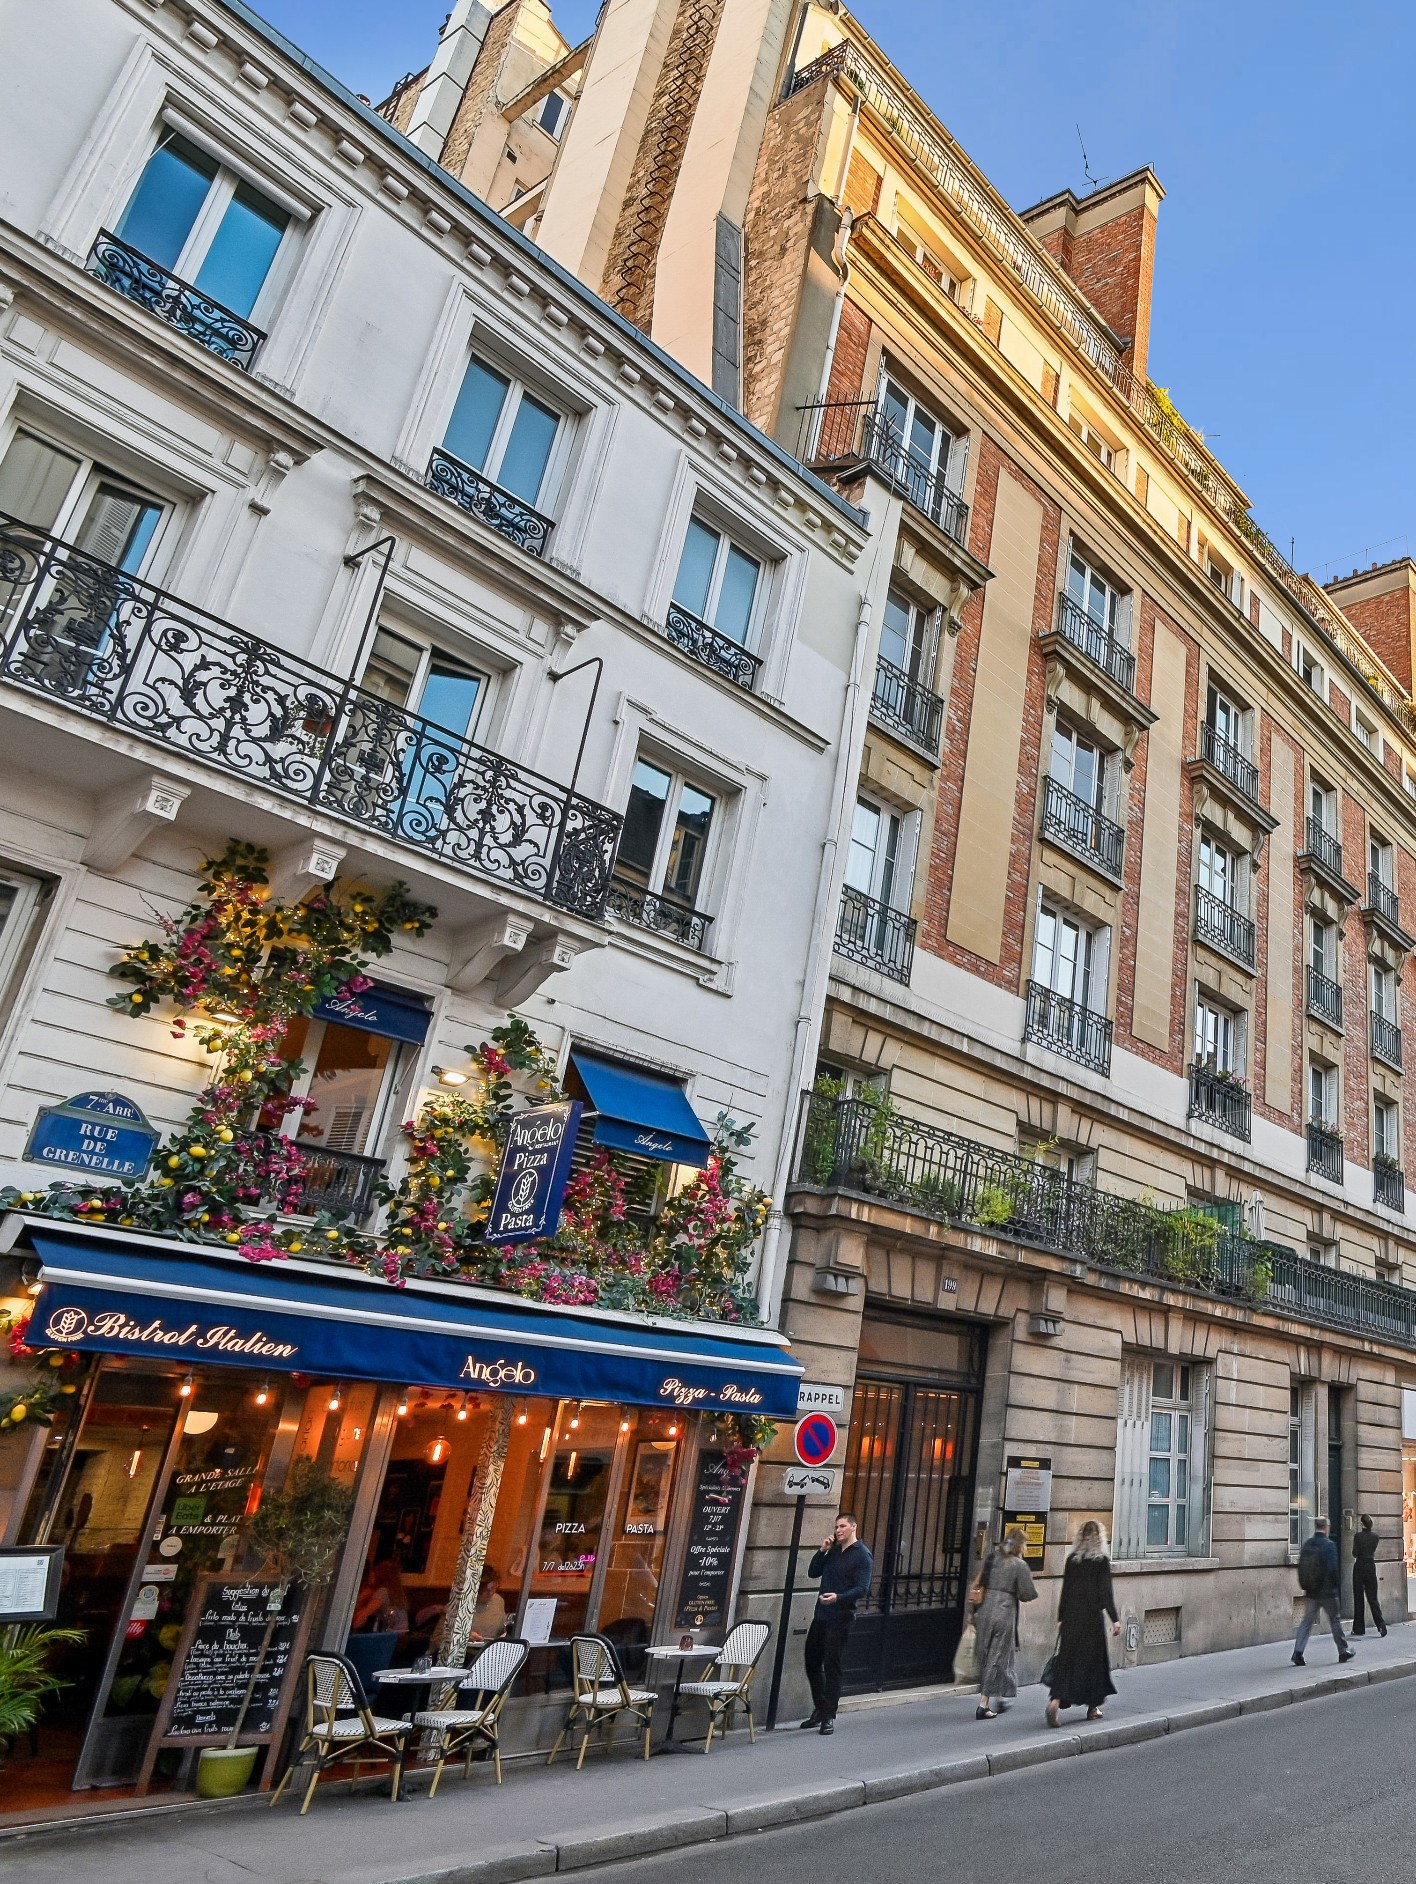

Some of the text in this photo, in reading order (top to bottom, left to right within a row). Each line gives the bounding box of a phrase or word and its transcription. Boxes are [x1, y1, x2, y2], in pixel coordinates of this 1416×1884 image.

[79, 1123, 118, 1141] RUE
[81, 1139, 107, 1154] DE
[42, 1146, 135, 1174] GRENELLE
[513, 1152, 548, 1170] Pizza
[499, 1213, 534, 1231] Pasta
[88, 1312, 299, 1357] Bistrot Italien
[459, 1355, 535, 1387] Angelo
[659, 1378, 708, 1405] Pizza
[719, 1384, 763, 1405] Pasta
[799, 1390, 841, 1406] RAPPEL
[702, 1506, 731, 1514] OUVERT
[555, 1523, 586, 1534] PIZZA
[626, 1523, 655, 1534] PASTA
[690, 1545, 731, 1555] Offre Spéciale
[126, 1621, 145, 1637] illy
